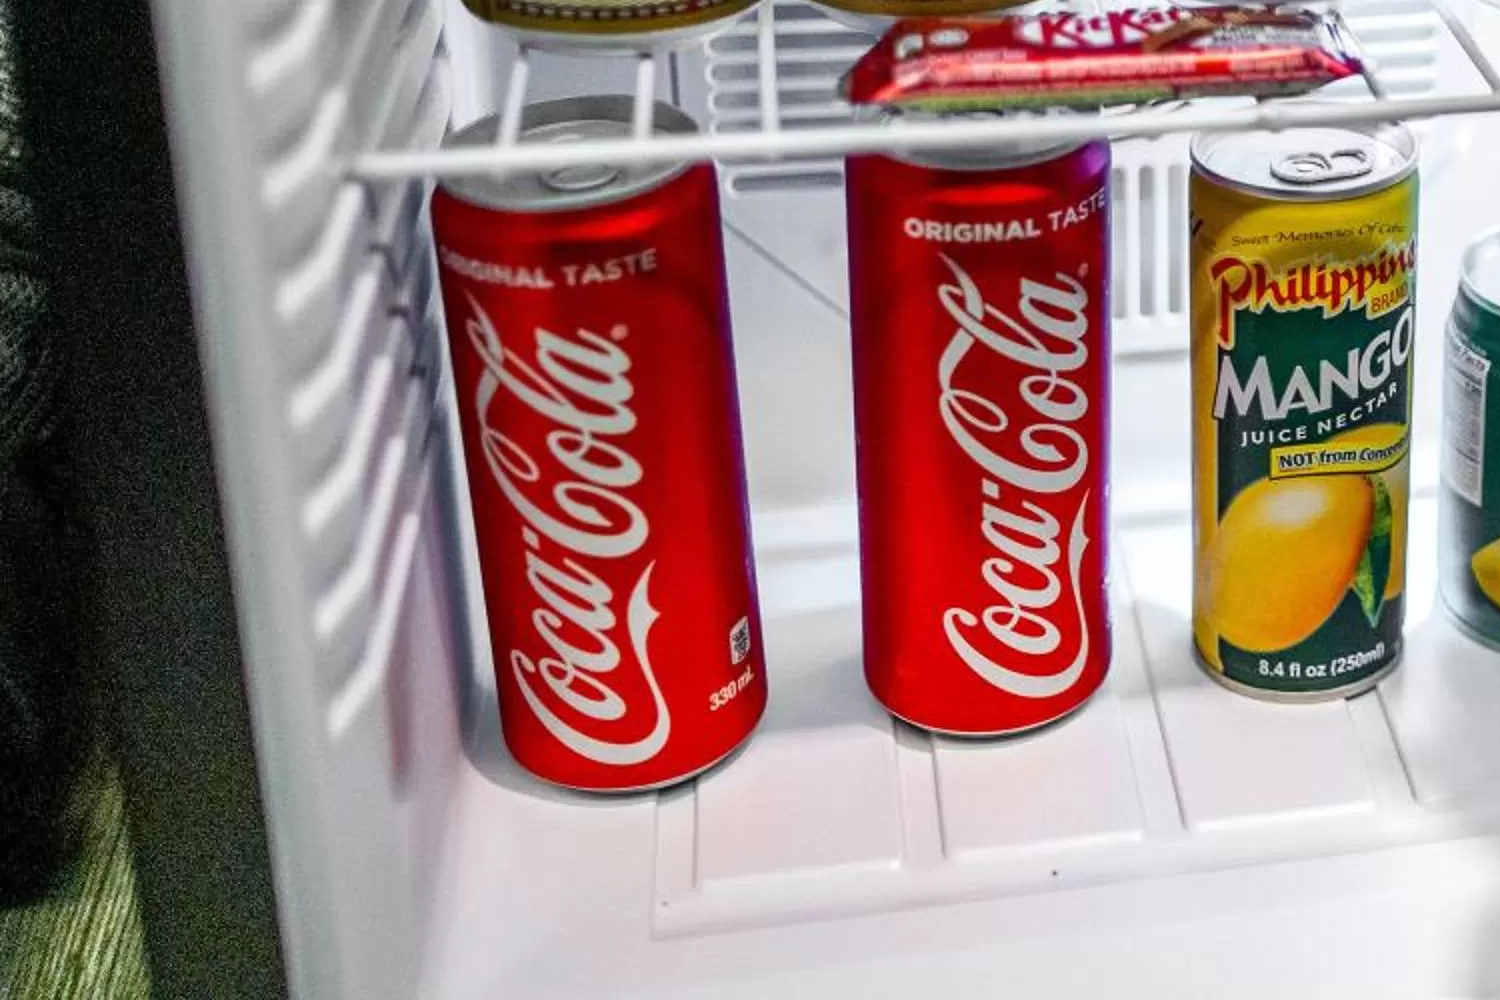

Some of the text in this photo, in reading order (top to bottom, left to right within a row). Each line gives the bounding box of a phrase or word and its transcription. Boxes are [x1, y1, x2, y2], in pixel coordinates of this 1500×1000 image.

[903, 186, 1105, 244] ORIGINAL TASTE
[561, 248, 656, 287] TASTE
[1213, 306, 1412, 420] MANGO
[1241, 382, 1397, 447] JUICE NECTAR
[938, 251, 1090, 698] Coca-Cola
[1278, 452, 1315, 469] NOT
[1319, 449, 1358, 465] from
[464, 288, 671, 766] Coca-Cola
[1259, 659, 1285, 677] 8.4
[1289, 661, 1300, 677] fl
[1306, 663, 1327, 677] oz
